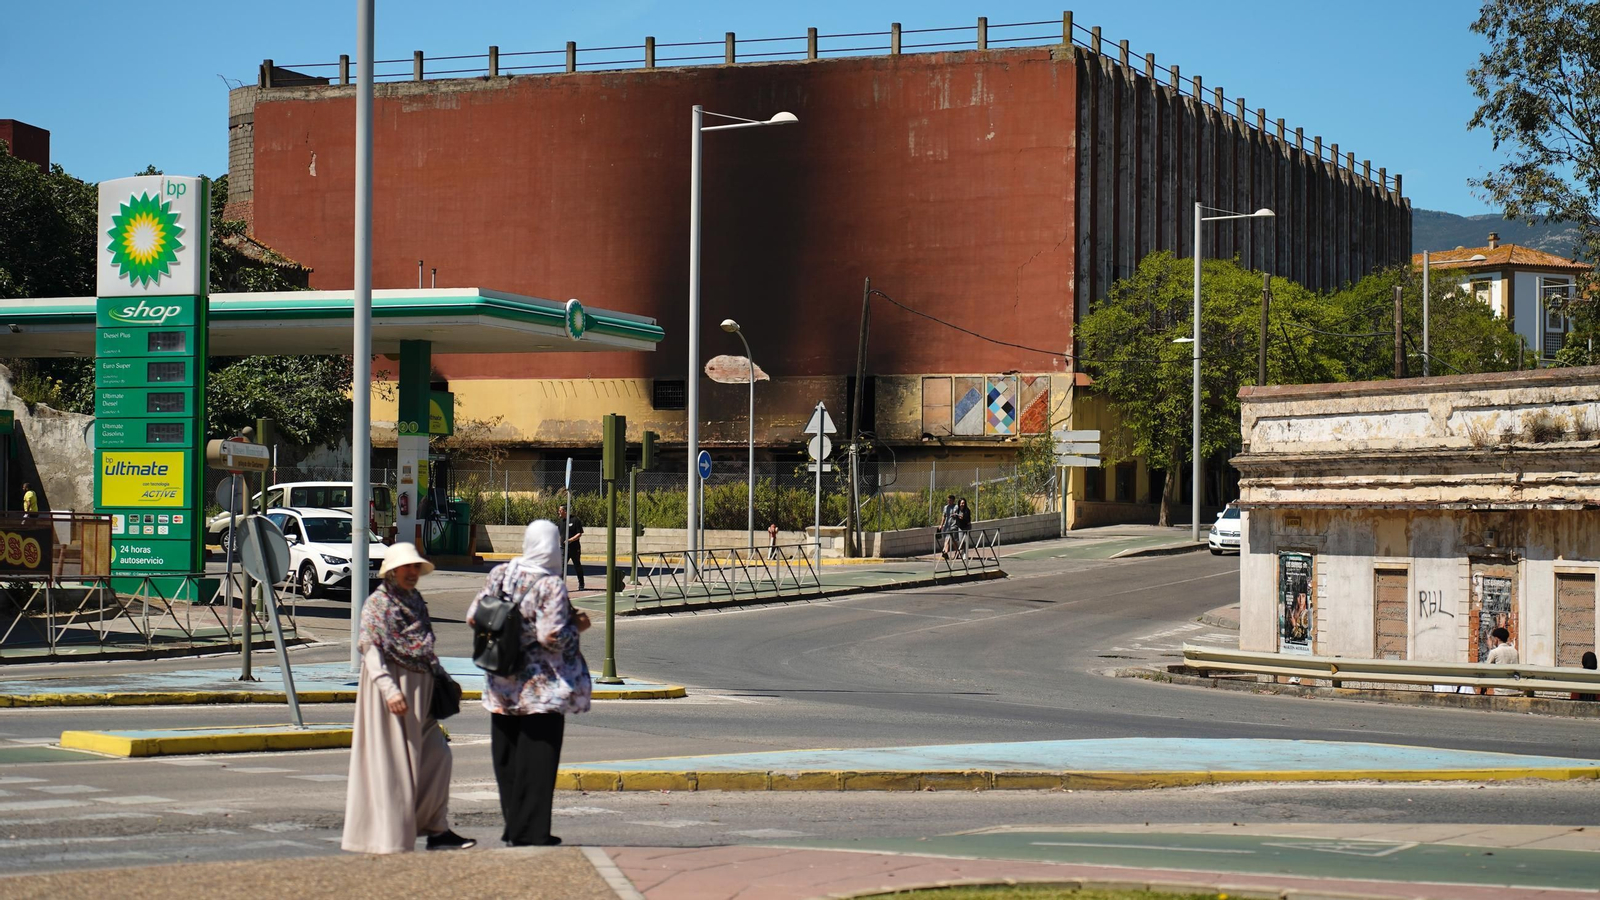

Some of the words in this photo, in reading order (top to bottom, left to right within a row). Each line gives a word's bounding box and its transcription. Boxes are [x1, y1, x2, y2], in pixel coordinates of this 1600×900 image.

[166, 179, 187, 199] bp
[120, 300, 183, 324] shop
[115, 362, 131, 370] Super
[105, 456, 114, 464] bp
[105, 461, 169, 476] ultimate
[141, 490, 178, 498] ACTIVE
[120, 545, 129, 554] 24
[130, 545, 152, 554] horas
[120, 556, 164, 565] autoservicio
